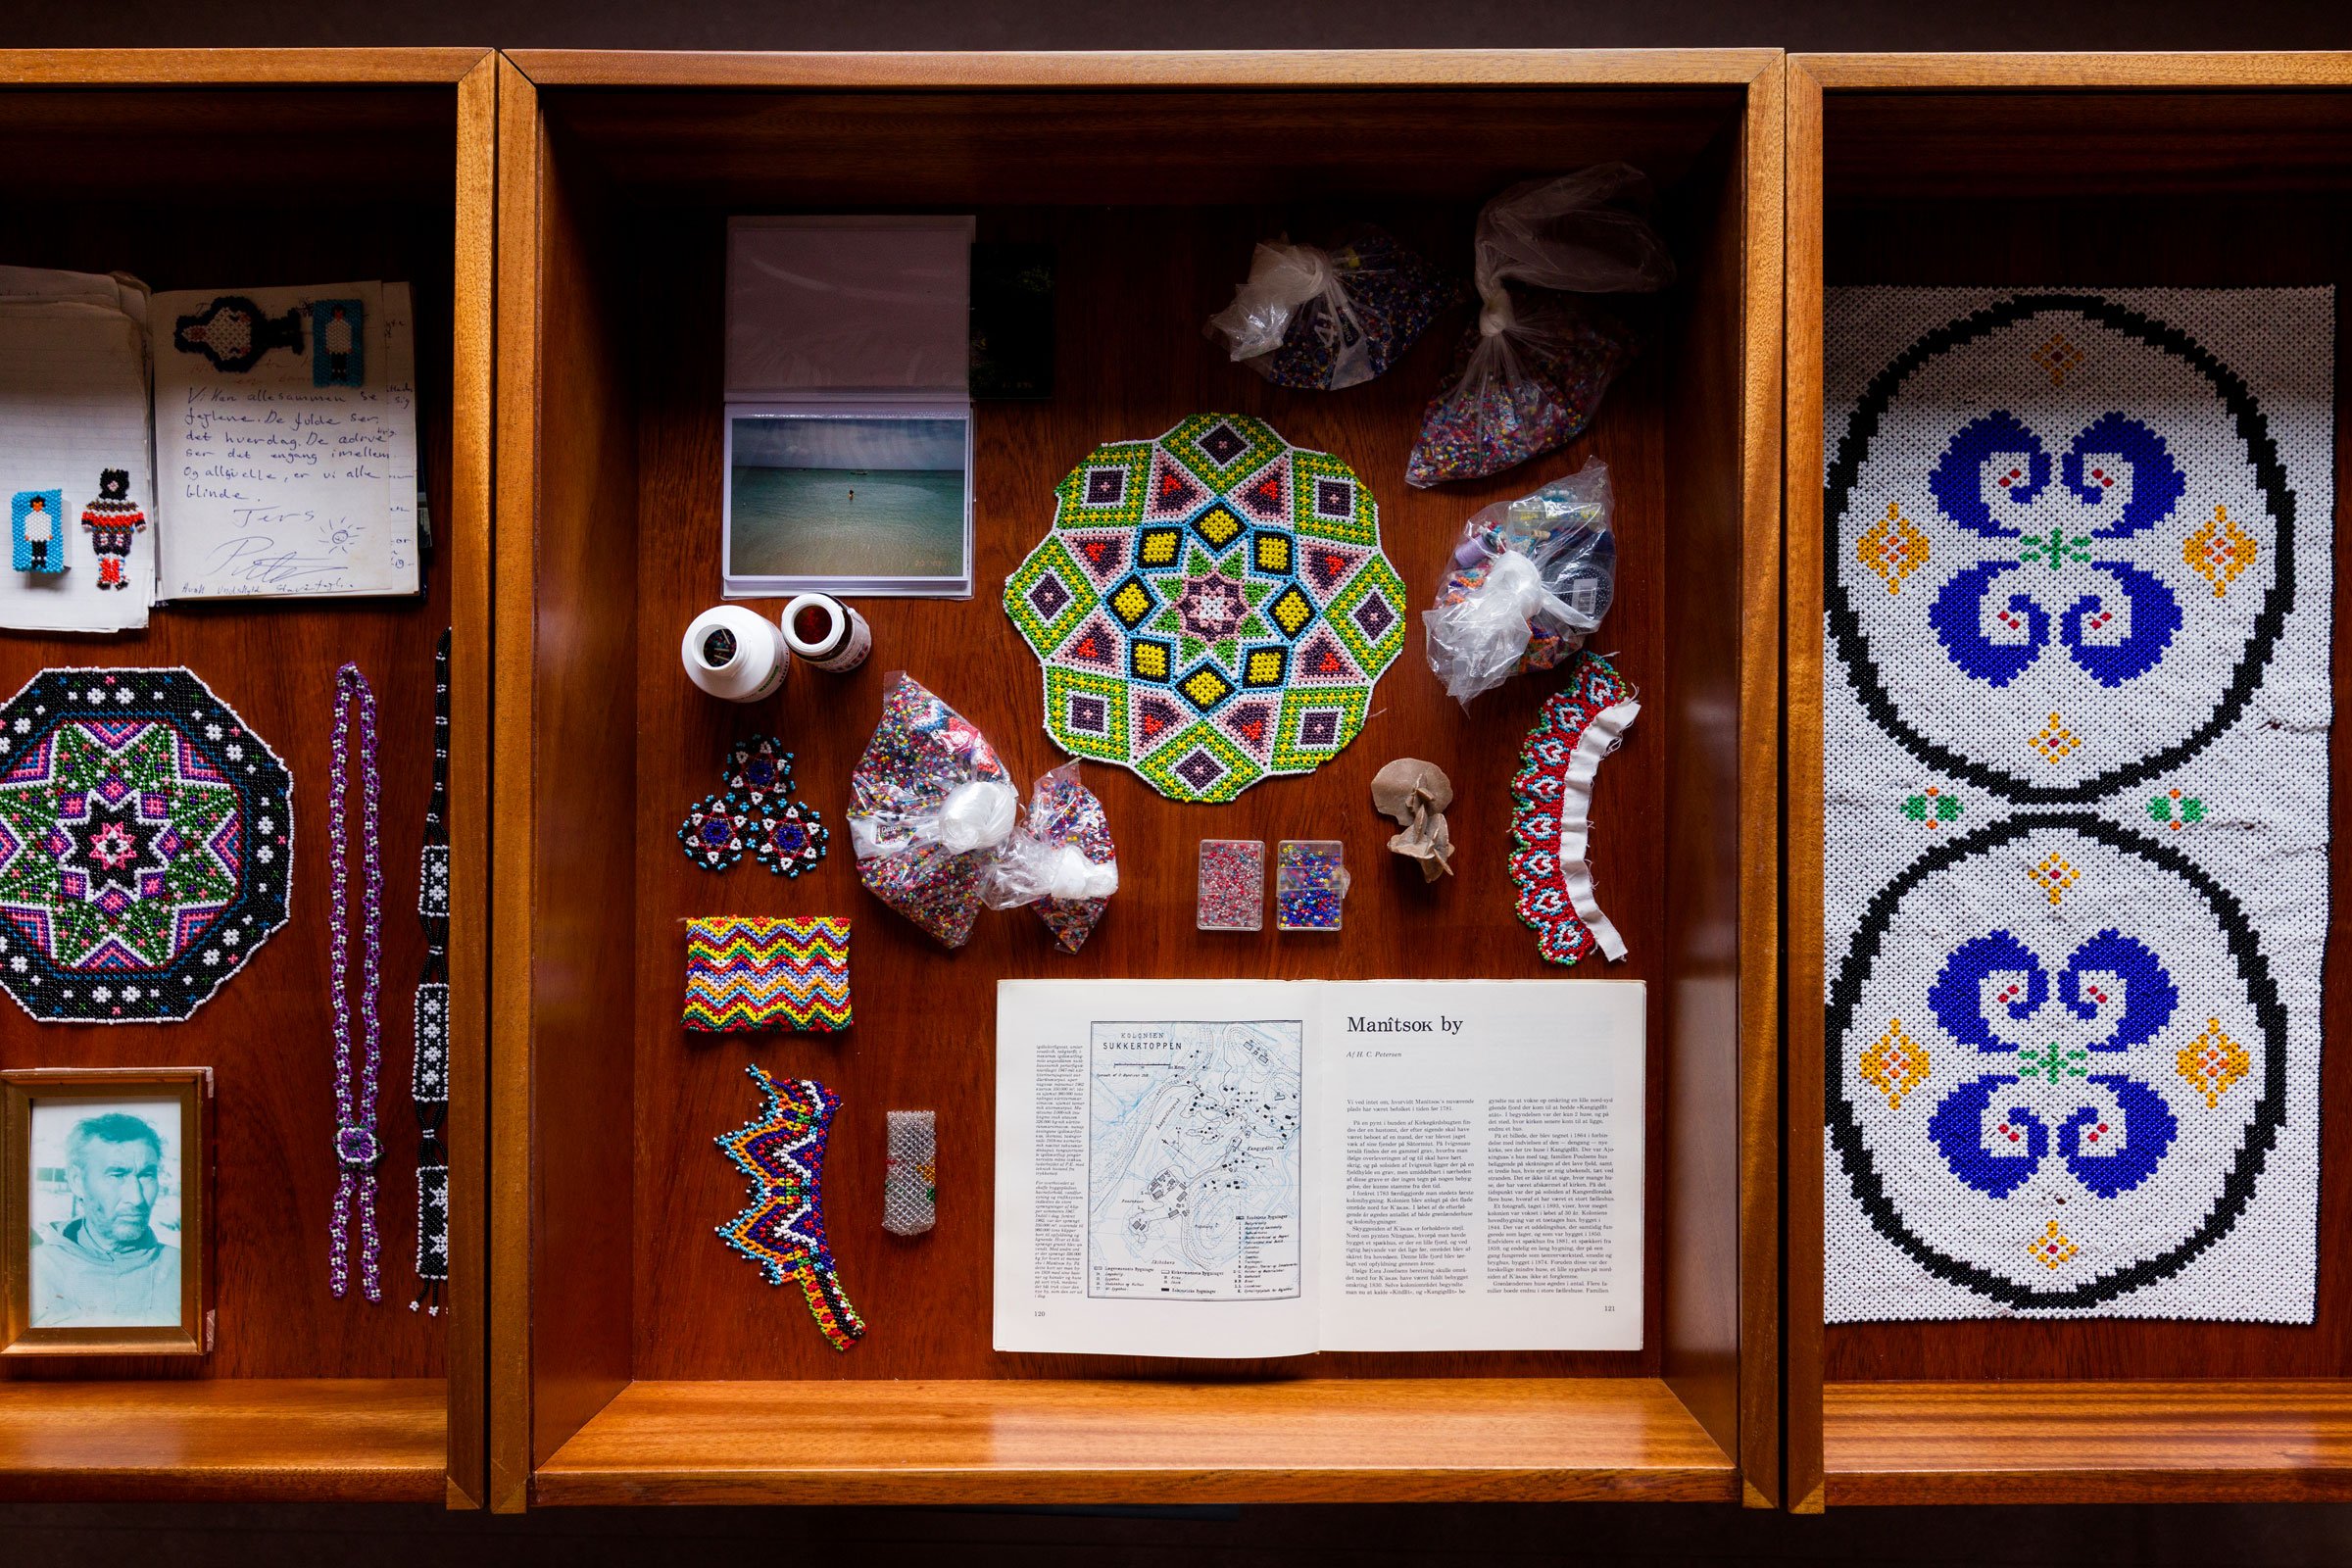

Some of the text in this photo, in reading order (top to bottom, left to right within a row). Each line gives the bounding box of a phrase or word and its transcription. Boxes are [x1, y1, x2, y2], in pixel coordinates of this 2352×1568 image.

[187, 386, 205, 404] Vi
[360, 392, 377, 402] se
[264, 412, 283, 425] De
[291, 412, 341, 431] fulde
[185, 430, 212, 442] det
[224, 431, 302, 448] hverdag.
[306, 432, 329, 446] De
[227, 448, 252, 459] det
[270, 453, 318, 464] engang
[183, 466, 199, 480] Og
[346, 465, 379, 478] alle
[1441, 1015, 1463, 1035] by
